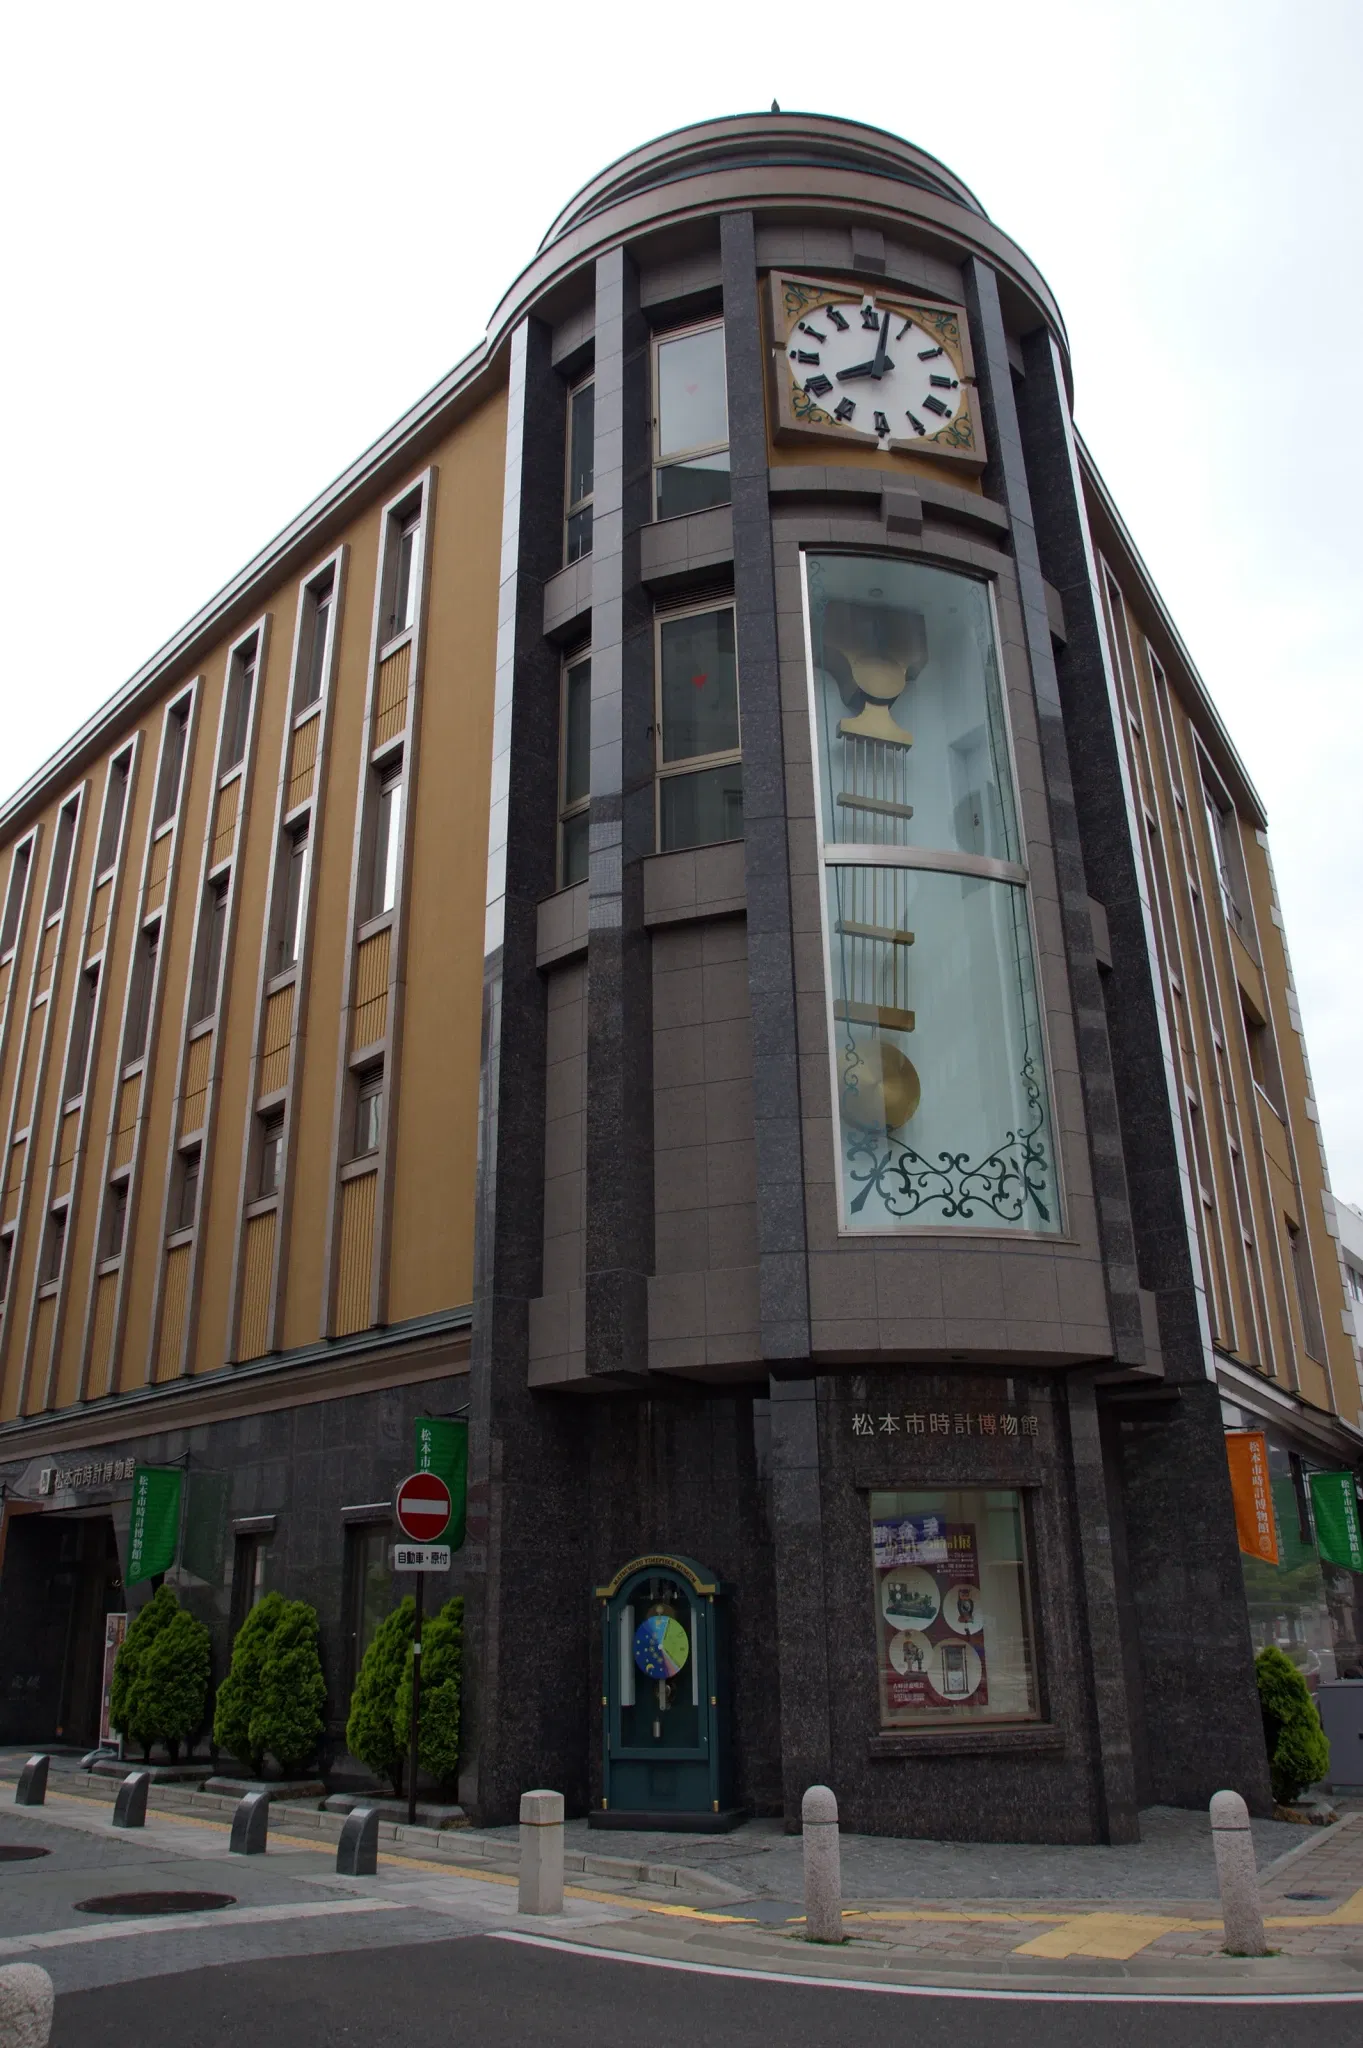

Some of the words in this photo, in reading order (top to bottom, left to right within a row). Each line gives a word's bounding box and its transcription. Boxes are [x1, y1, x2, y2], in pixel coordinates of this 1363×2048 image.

[851, 1412, 1040, 1437] 松本市時計博物館
[418, 1427, 432, 1473] 松本市
[55, 1457, 136, 1490] 松本市時計博物館
[1249, 1441, 1269, 1534] 松本市時計博物館
[131, 1475, 149, 1560] 松本市時計博物館
[1340, 1479, 1360, 1552] 松本市時計博物館
[398, 1551, 448, 1565] 自動車・原付
[613, 1559, 644, 1585] MATSUMOTO
[676, 1563, 697, 1584] MUSEUM
